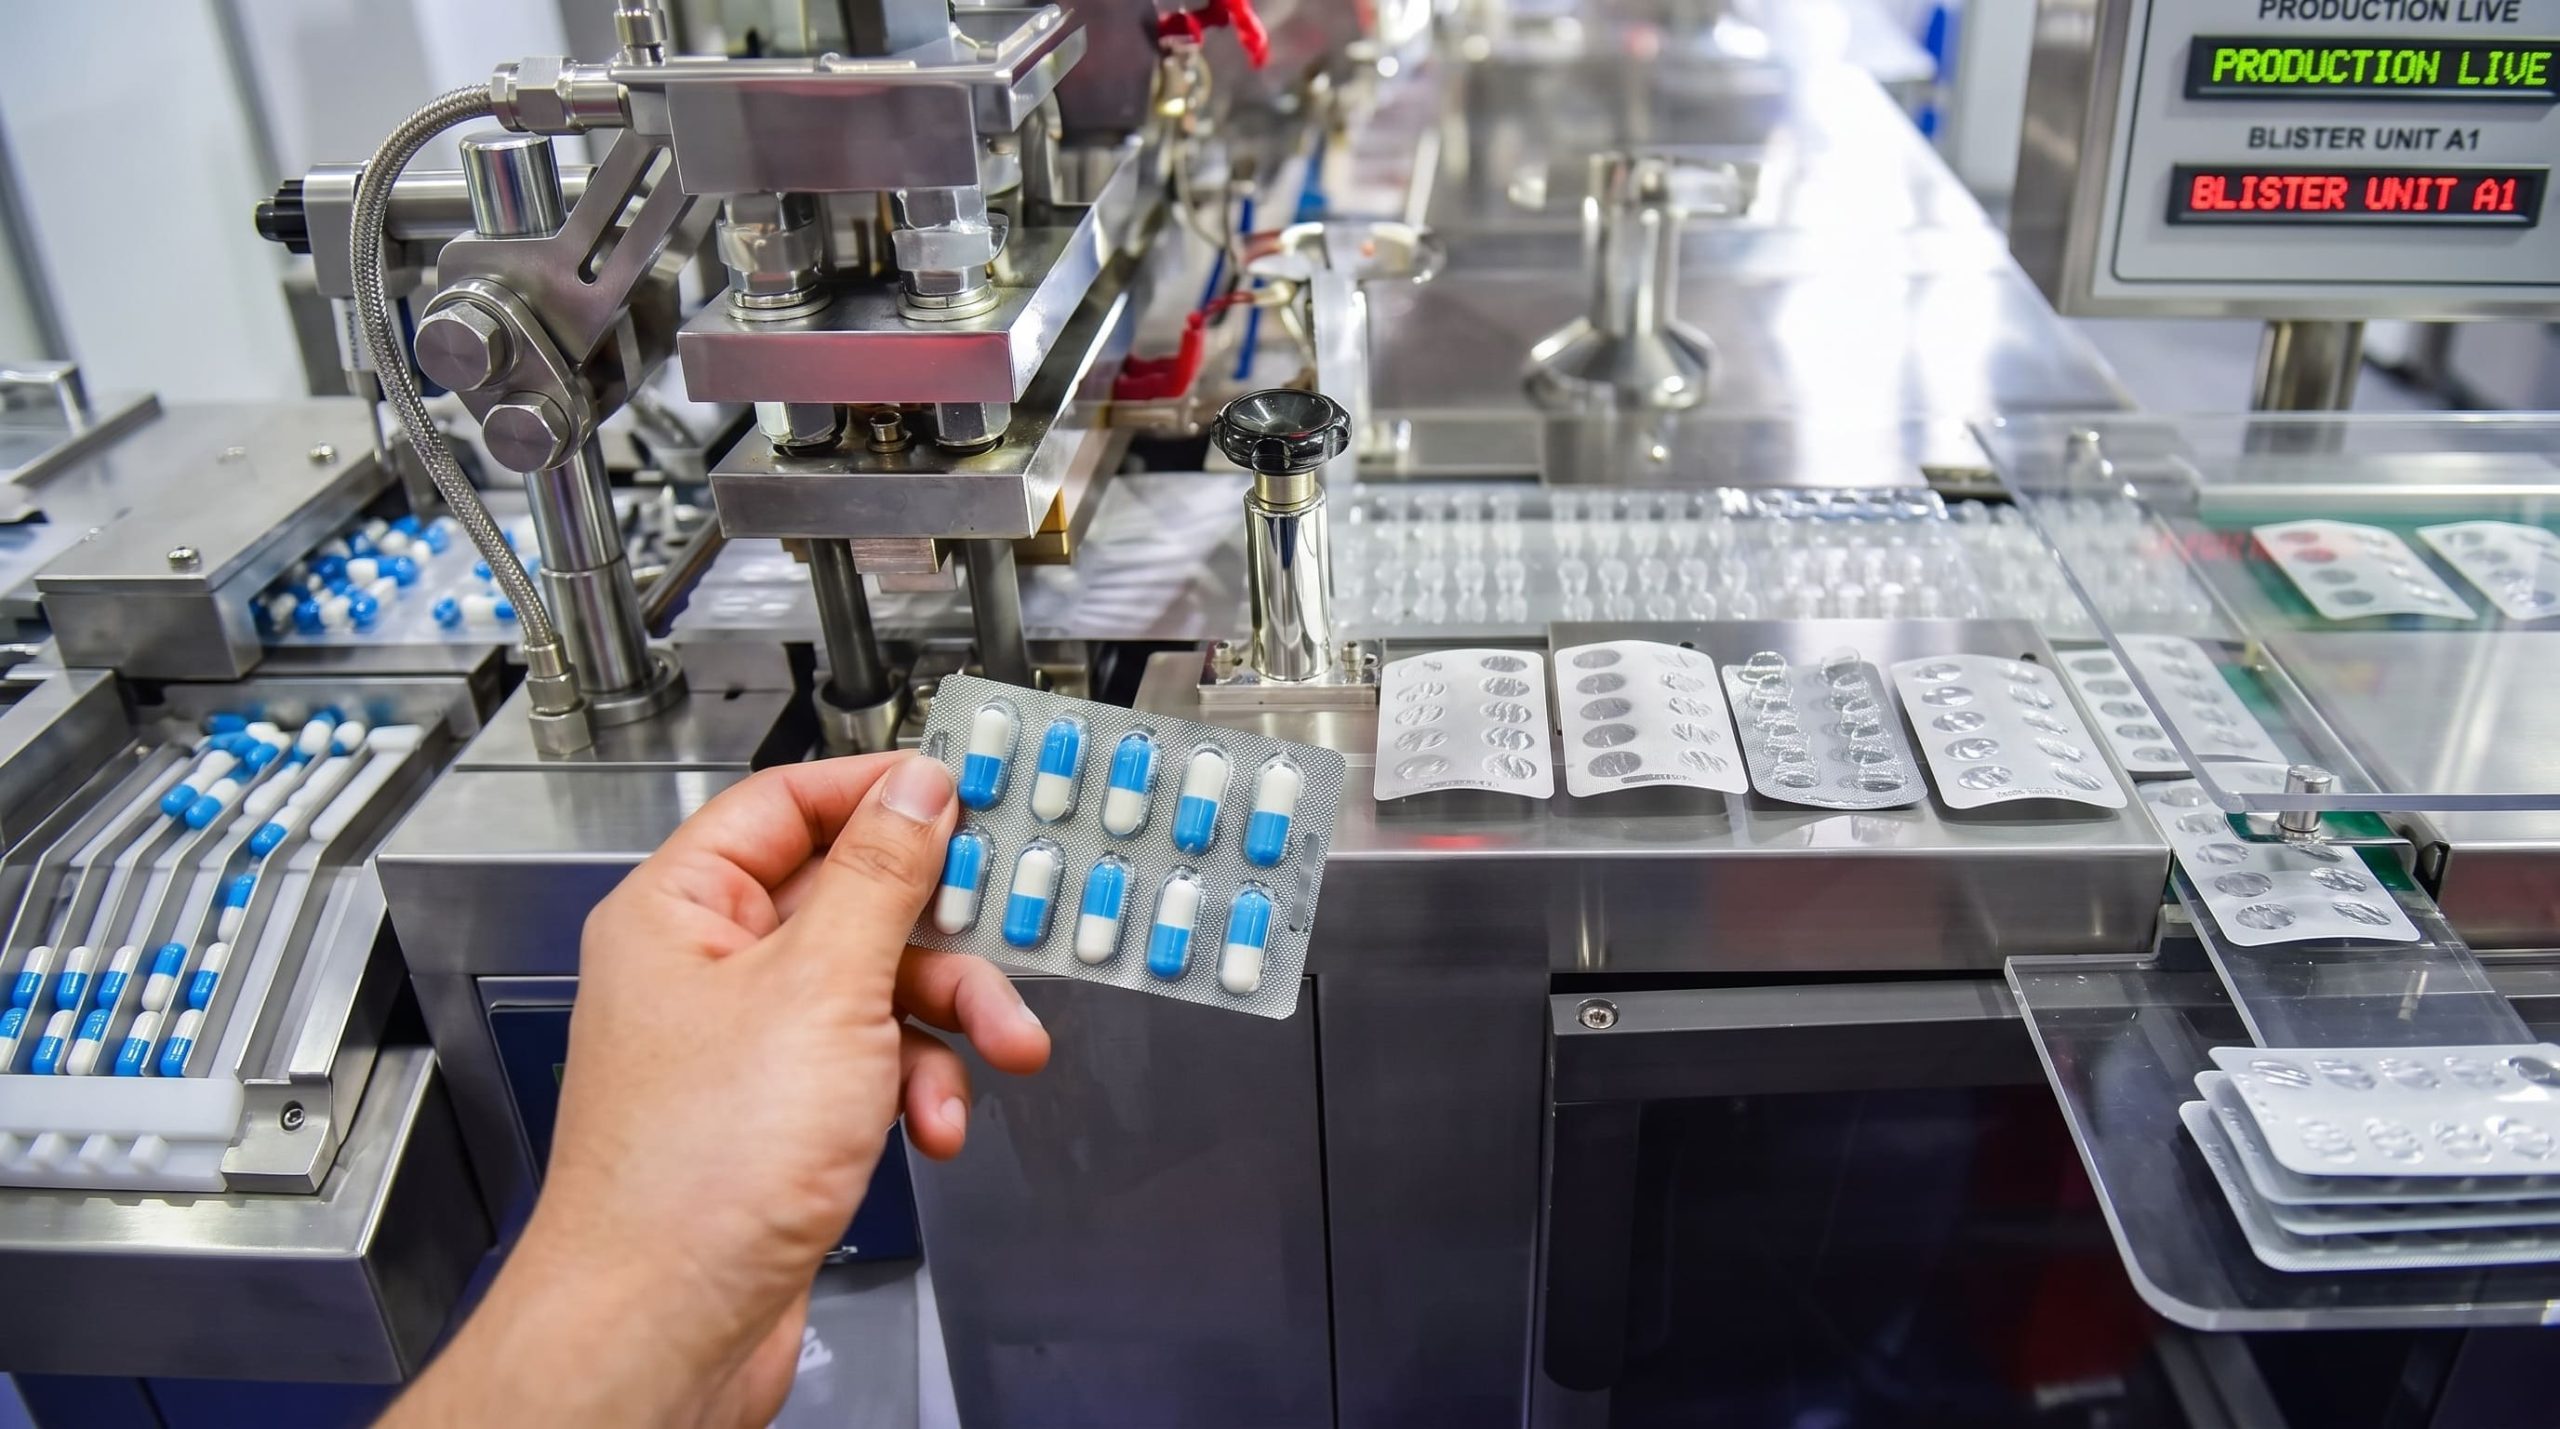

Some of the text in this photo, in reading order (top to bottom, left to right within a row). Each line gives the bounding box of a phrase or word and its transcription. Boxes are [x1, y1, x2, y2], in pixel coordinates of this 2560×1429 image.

[2258, 0, 2521, 22] PRODUCTION LIVE
[2212, 48, 2552, 85] PRODUCTION LIVE
[2248, 126, 2480, 151] BLISTER UNIT A1
[2191, 175, 2516, 211] BLISTER UNIT A1
